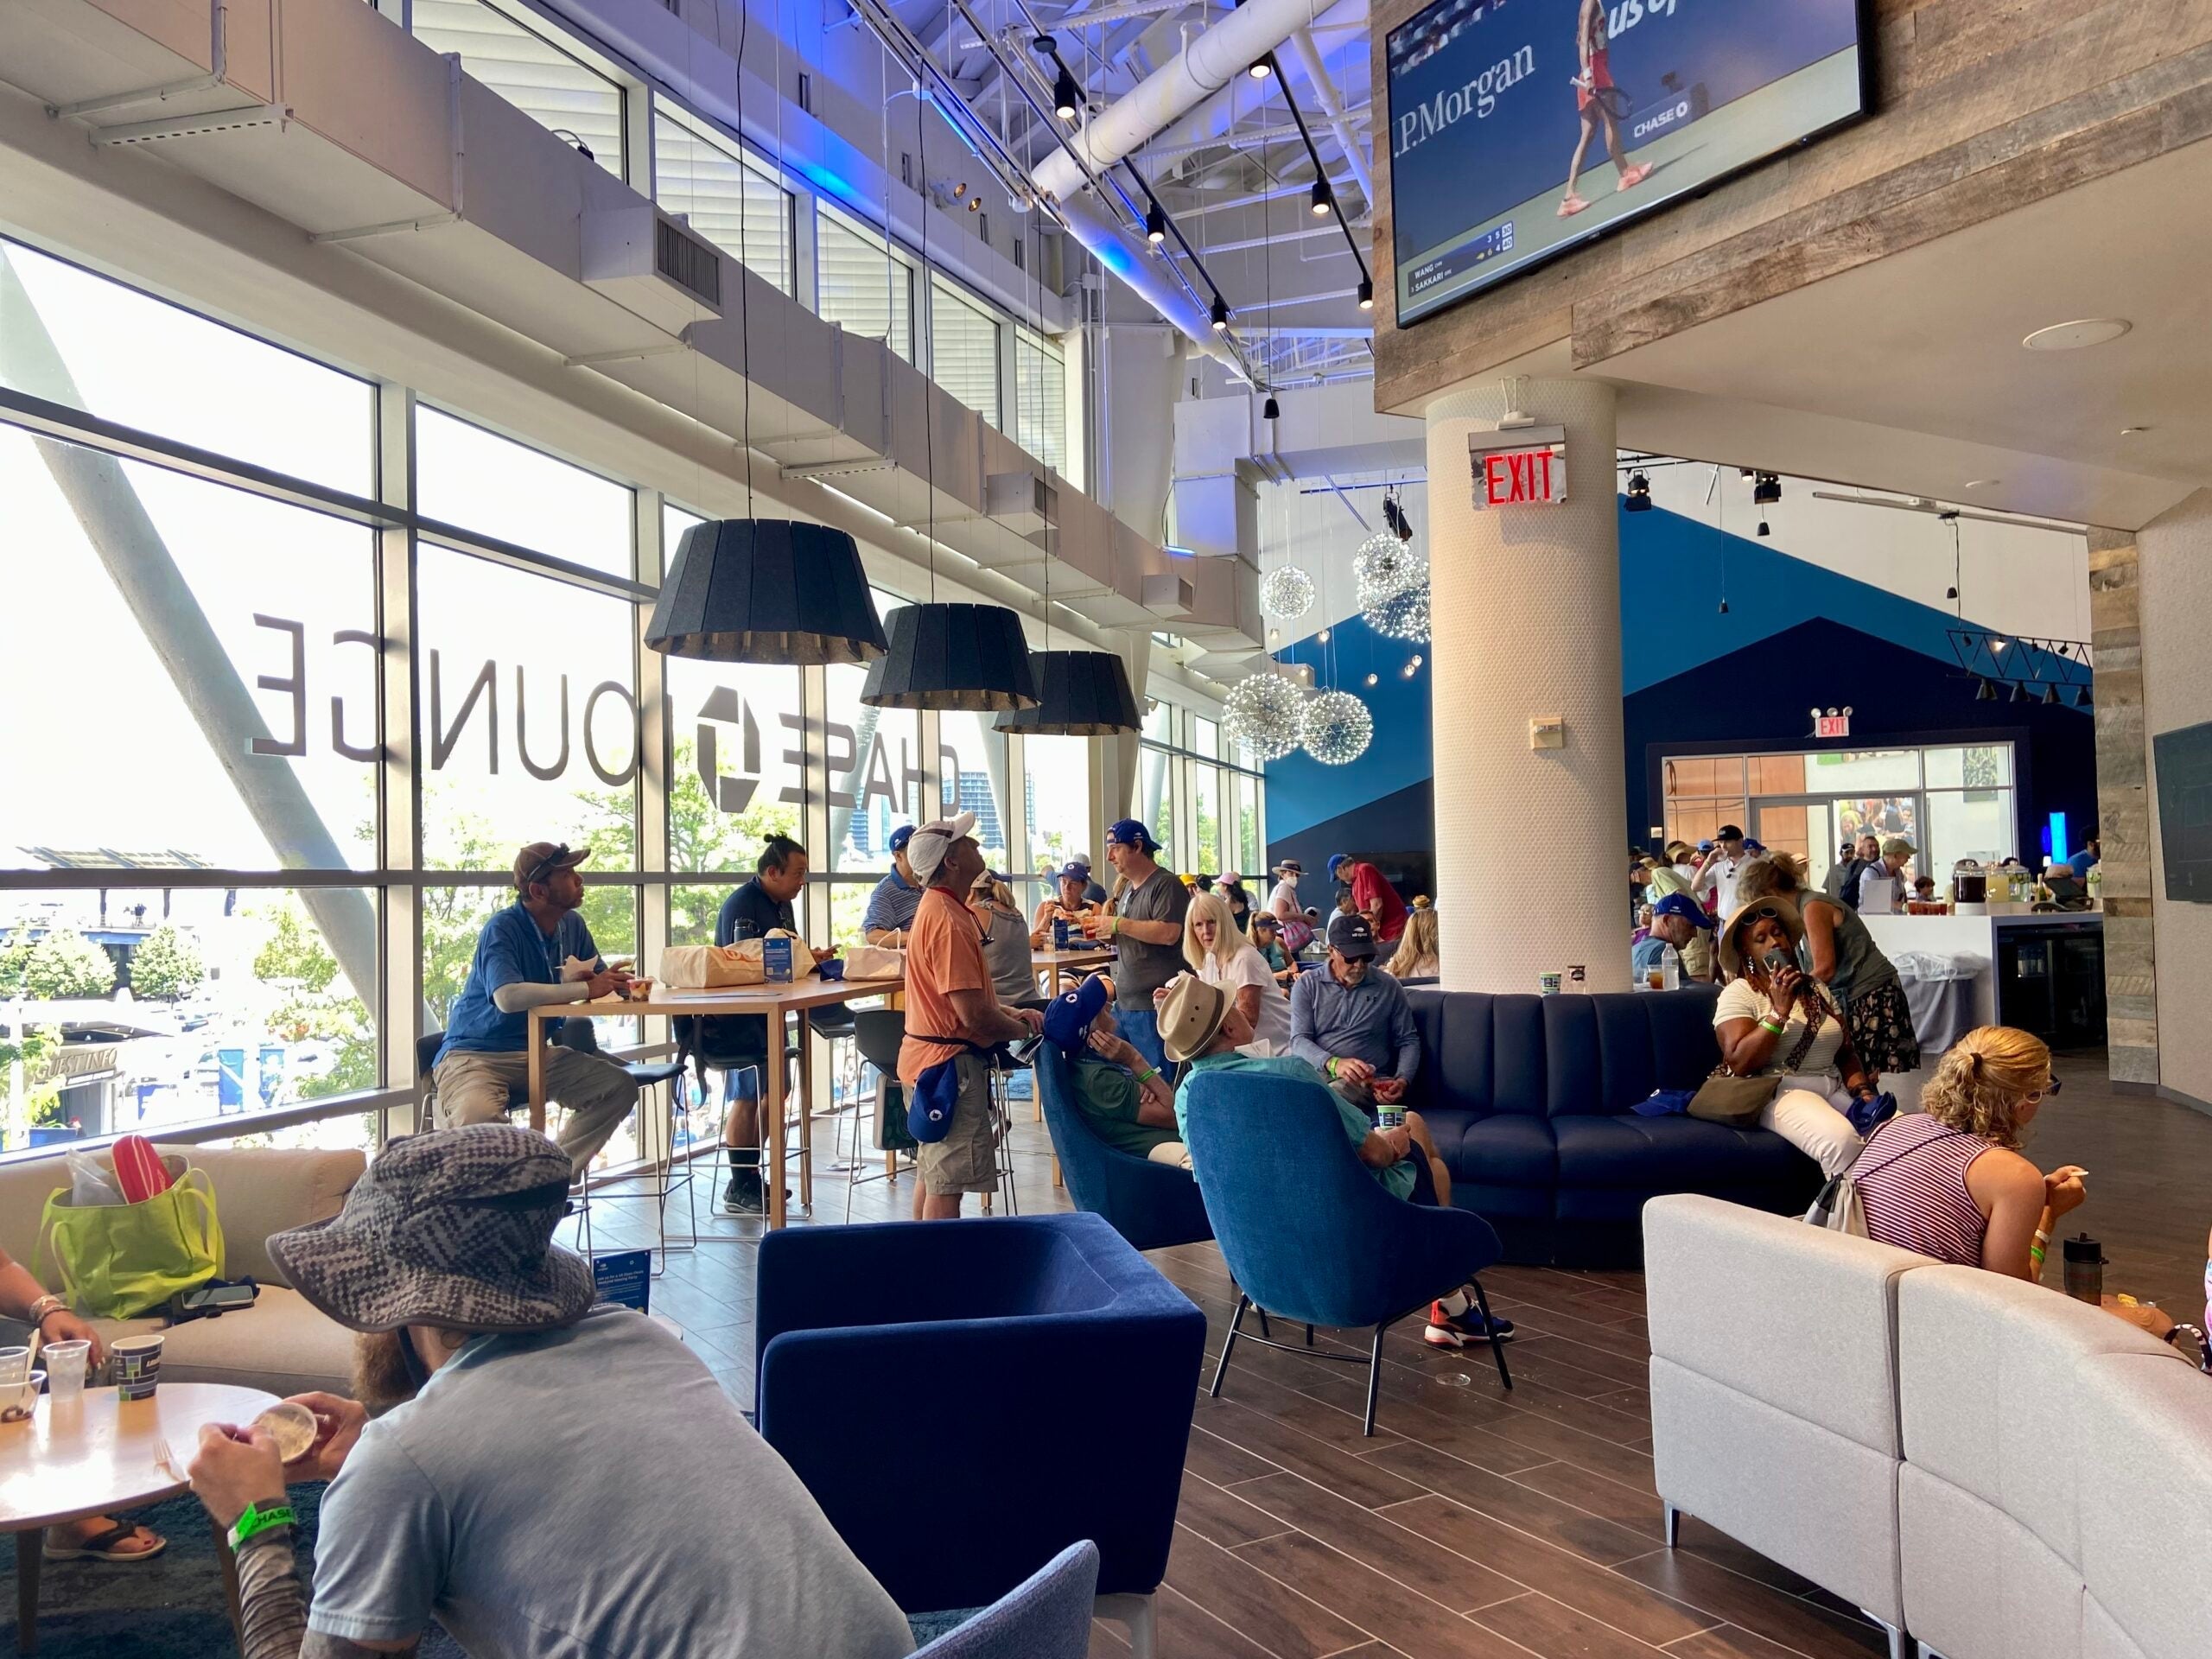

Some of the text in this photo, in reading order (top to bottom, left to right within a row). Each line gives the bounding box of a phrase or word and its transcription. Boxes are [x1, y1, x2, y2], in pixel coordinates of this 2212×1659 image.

[1393, 45, 1535, 158] .P.Morgan
[1633, 107, 1675, 138] CHASE
[1414, 264, 1434, 279] WANG
[1495, 231, 1501, 240] 5
[1415, 271, 1444, 292] SAKKARI
[1485, 449, 1554, 505] EXIT
[1820, 717, 1847, 735] EXIT
[35, 1047, 118, 1079] GUEST INFO
